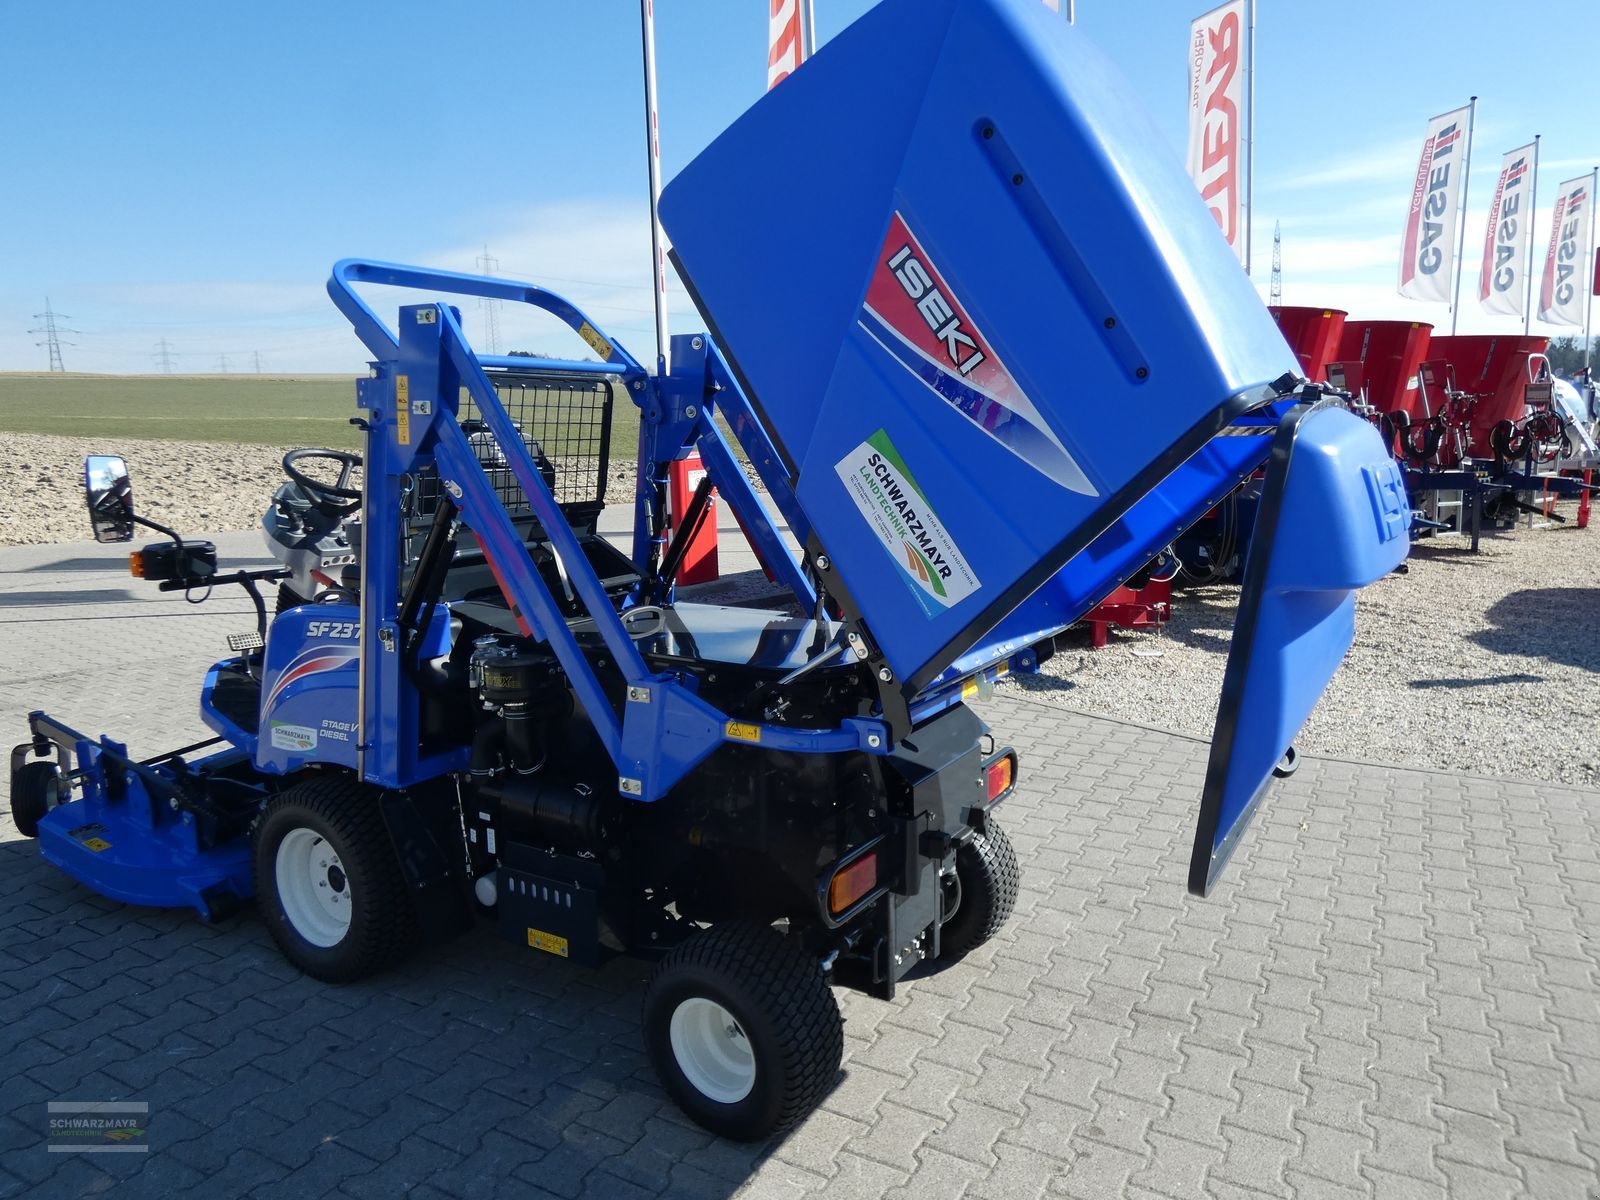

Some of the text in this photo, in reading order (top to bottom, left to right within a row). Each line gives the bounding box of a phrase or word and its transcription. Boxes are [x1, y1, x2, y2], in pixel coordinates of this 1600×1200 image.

[887, 244, 986, 377] ISEKI
[859, 465, 908, 539] LANDTECHNIK
[867, 453, 952, 580] SCHWARZMAYR
[926, 513, 937, 529] MEHR
[936, 528, 944, 539] ALS
[943, 539, 952, 551] NUR
[306, 621, 361, 639] SF237
[319, 729, 349, 742] DIESEL
[321, 719, 350, 732] STAGE
[350, 722, 359, 732] V
